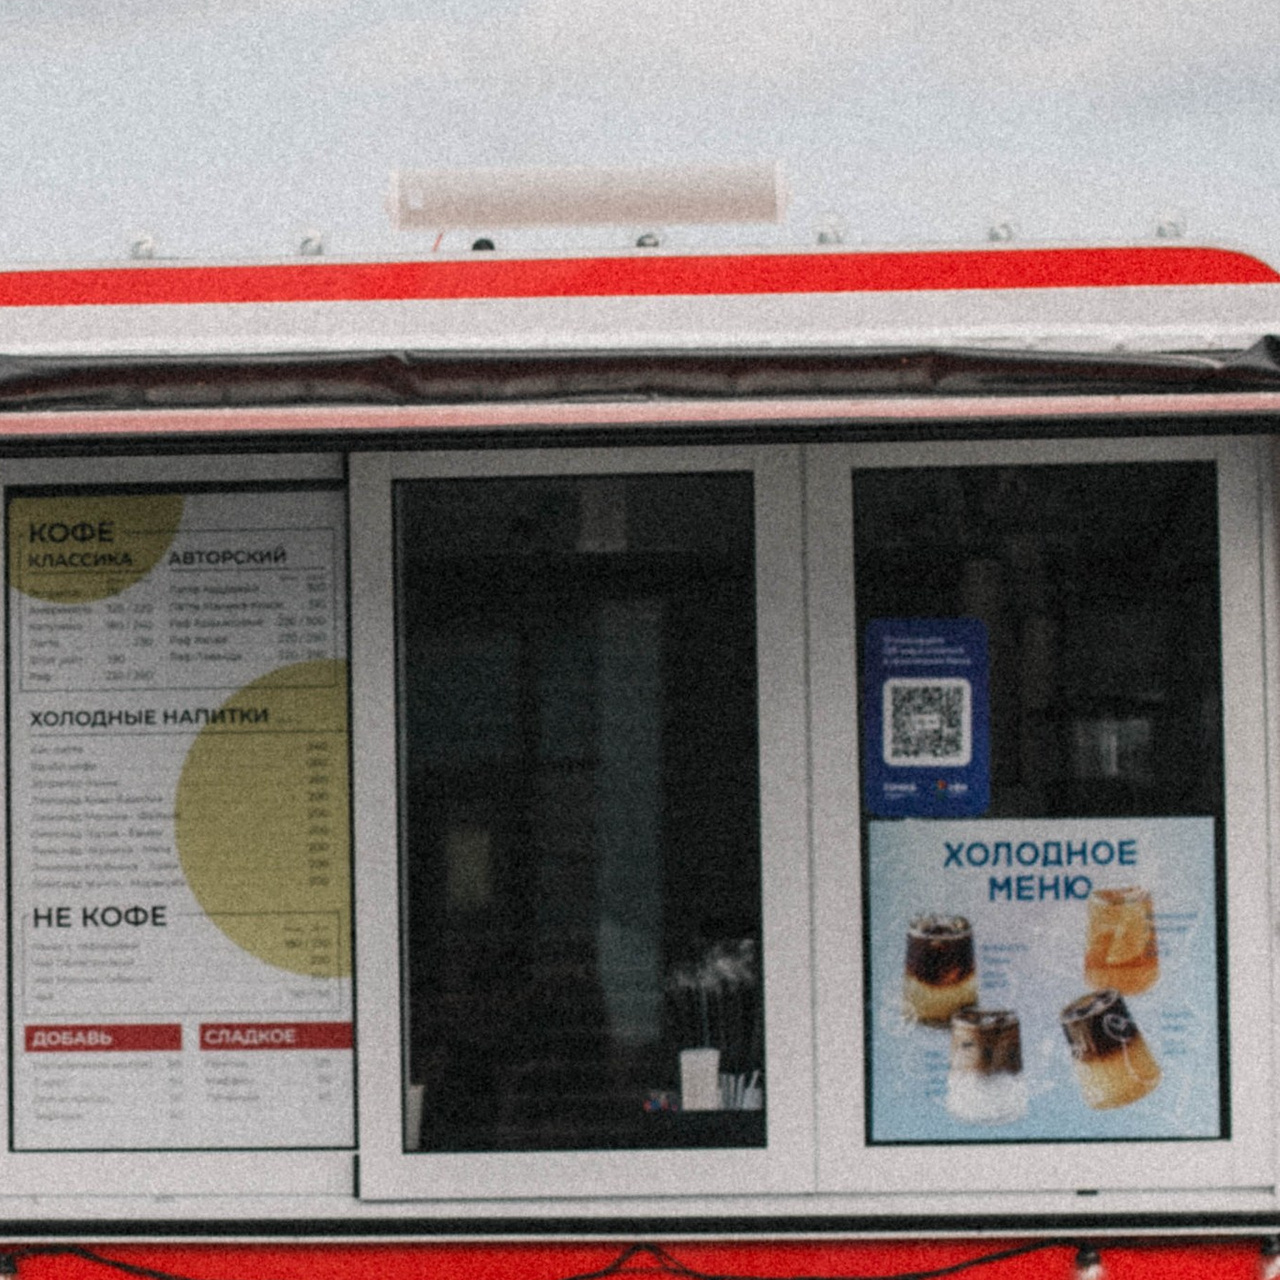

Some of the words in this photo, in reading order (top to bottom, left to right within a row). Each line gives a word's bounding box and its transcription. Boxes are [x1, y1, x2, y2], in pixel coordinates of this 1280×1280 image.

[29, 522, 115, 544] КОФЕ
[28, 552, 133, 568] КЛАССИКА
[169, 545, 287, 565] АВТОРСКИЙ
[30, 709, 156, 729] ХОЛОДНЫЕ
[163, 707, 269, 726] НАПИТКИ
[943, 839, 1137, 869] ХОЛОДНОЕ
[988, 875, 1093, 902] МЕНЮ
[33, 907, 72, 928] НЕ
[82, 905, 168, 927] КОФЕ
[31, 1030, 113, 1048] ДОБАВЬ
[204, 1028, 297, 1046] СЛАДКОЕ
